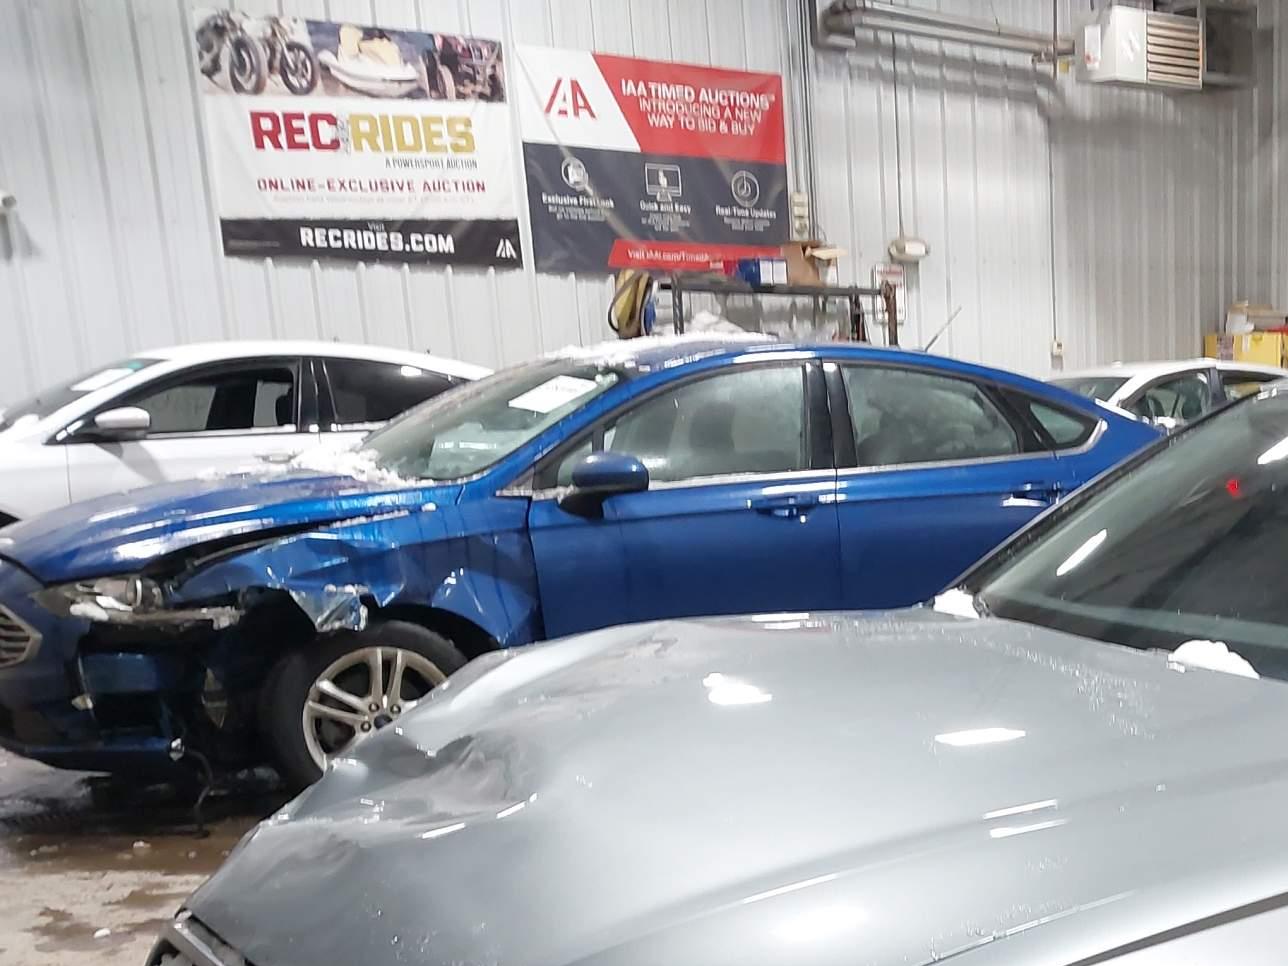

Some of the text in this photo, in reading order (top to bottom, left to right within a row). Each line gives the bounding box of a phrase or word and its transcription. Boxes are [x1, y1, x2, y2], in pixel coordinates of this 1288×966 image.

[620, 79, 647, 97] IAA
[648, 82, 695, 103] TIMED
[639, 96, 721, 119] INTRODUCING
[735, 108, 762, 124] NEW
[648, 114, 676, 129] WAY
[680, 116, 695, 131] TO
[699, 118, 716, 133] BID
[732, 122, 756, 136] BUY
[392, 159, 444, 170] POWERSPORT
[446, 160, 478, 170] AUCTION
[257, 178, 487, 194] ONLINE-EXCLUSIVE AUCTION
[299, 226, 455, 254] RECRIDES.COM
